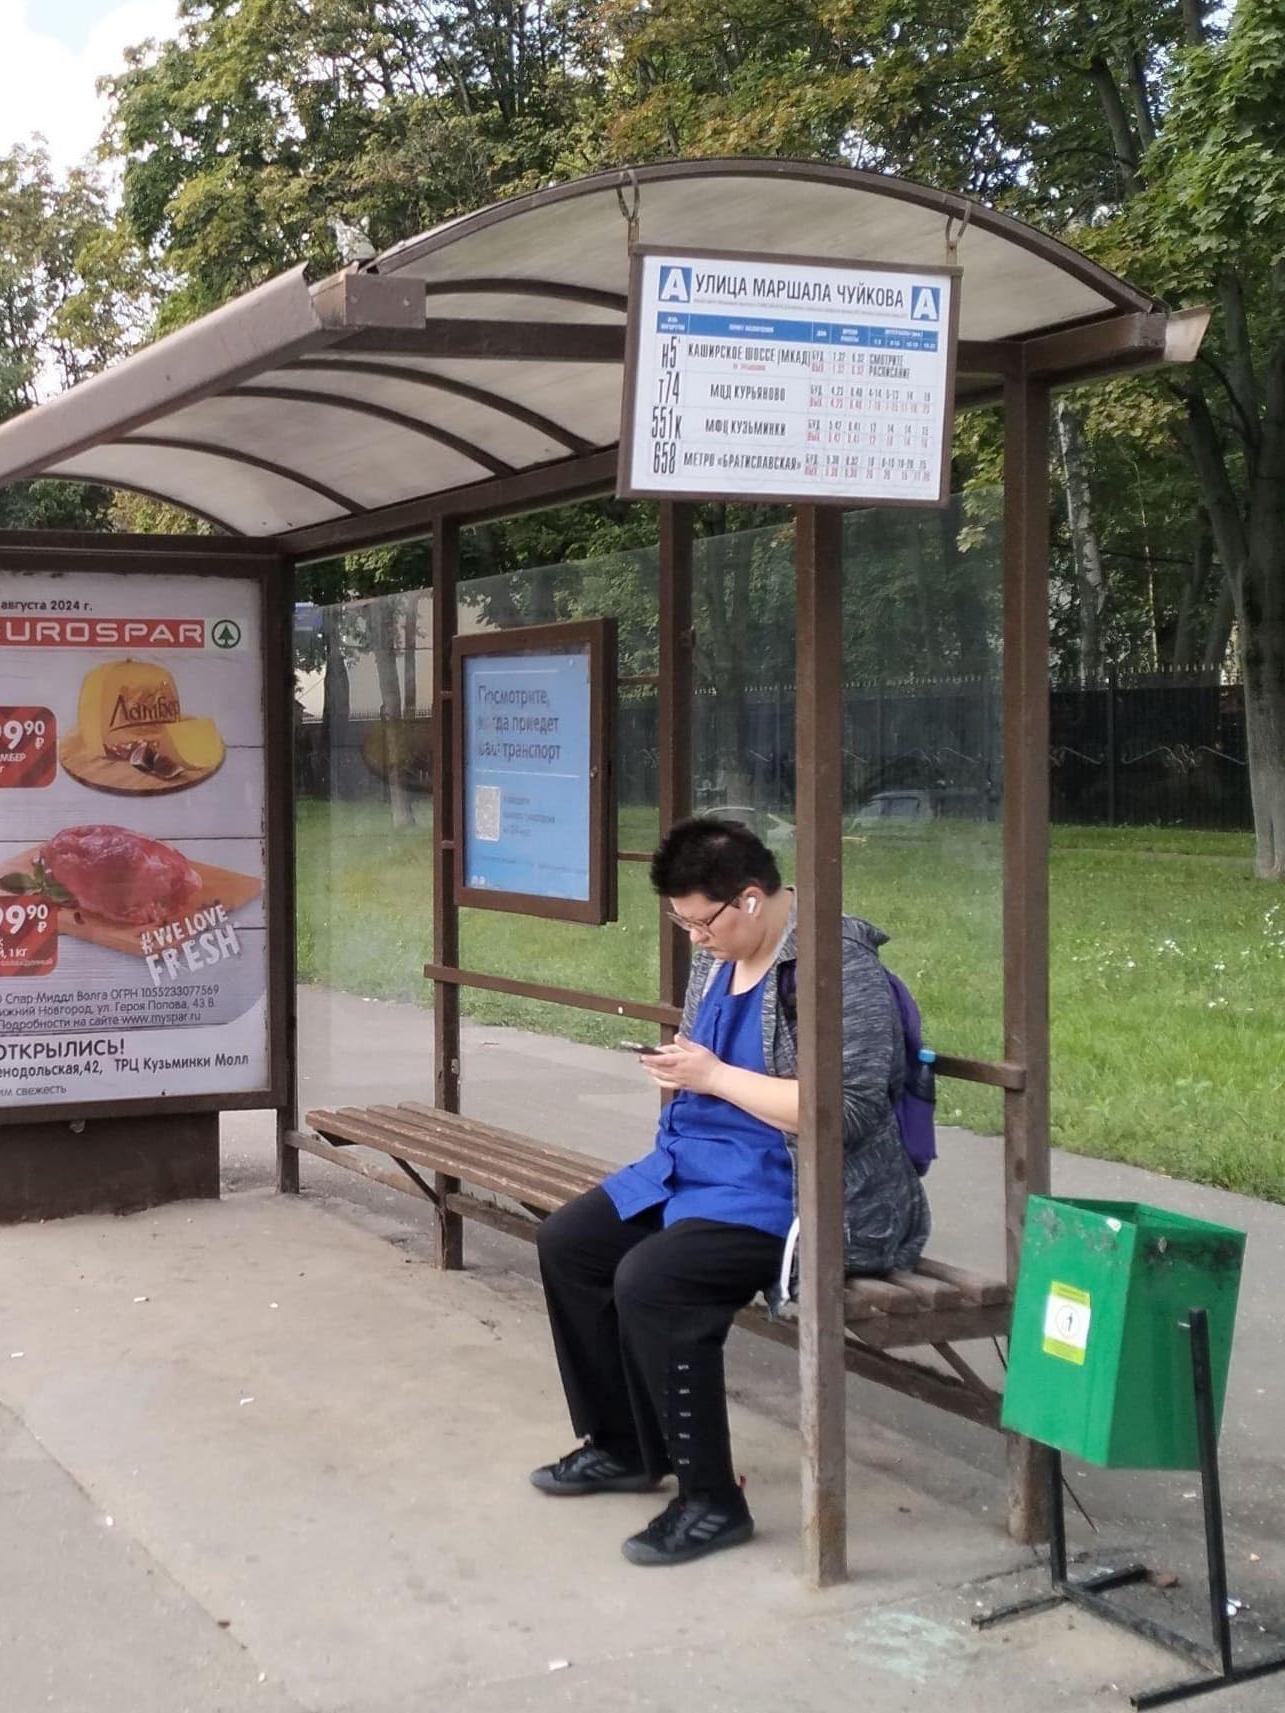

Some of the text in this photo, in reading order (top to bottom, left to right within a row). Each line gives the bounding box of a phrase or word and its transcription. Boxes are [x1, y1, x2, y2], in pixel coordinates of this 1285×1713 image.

[696, 273, 748, 299] УЛИЦА
[753, 278, 832, 303] МАРШАЛА
[837, 281, 904, 308] ЧУЙКОВА
[688, 343, 742, 360] КАШИРСКОЕ
[745, 346, 776, 362] ШОССЕ
[777, 348, 811, 367] (МКАД)
[710, 383, 732, 400] МЦД
[734, 385, 786, 401] КУРЬЯНОВО
[705, 418, 729, 436] МФЦ
[731, 419, 786, 437] КУЗЬМИНКИ
[653, 441, 677, 475] 658
[683, 452, 715, 467] МЕТРО
[717, 453, 802, 471] «БРАТИСЛАВСКАЯ»
[1, 600, 47, 613] августа
[50, 600, 80, 611] 2024
[84, 602, 93, 612] г.
[512, 716, 559, 735] приедет
[501, 743, 561, 764] транспорт
[139, 904, 229, 955] #WE LOVE
[16, 948, 28, 957] КГ
[145, 925, 240, 987] FRESH
[5, 993, 34, 1006] Спар
[36, 991, 74, 1004] Миддл
[77, 990, 108, 1001] Волга
[110, 988, 138, 1000] ОГРН
[141, 984, 220, 998] 1055233077569
[115, 1001, 146, 1013] Героя
[192, 998, 205, 1009] 43
[73, 1018, 86, 1027] на
[89, 1014, 119, 1026] сайте
[122, 1012, 201, 1025] www.myspar.ru
[114, 1058, 140, 1073] ТРЦ
[143, 1057, 211, 1073] Кузьминки
[215, 1053, 249, 1067] Молл
[16, 1085, 67, 1097] свежесть
